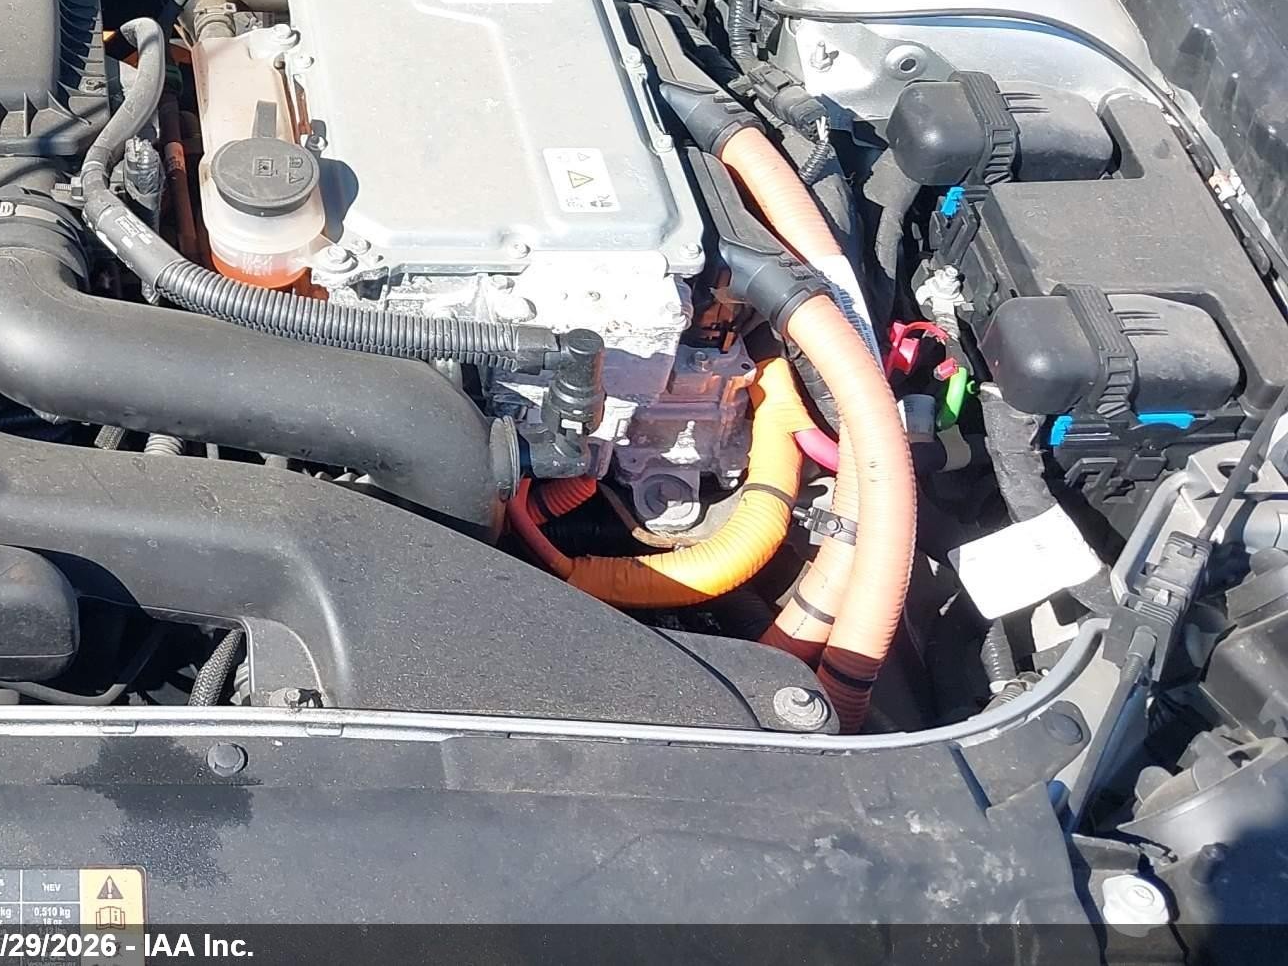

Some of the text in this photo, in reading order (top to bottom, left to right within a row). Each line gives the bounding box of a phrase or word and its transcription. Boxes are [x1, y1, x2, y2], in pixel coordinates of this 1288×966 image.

[43, 882, 62, 892] HEV
[0, 905, 12, 918] kg
[33, 905, 71, 918] 0.510 kg
